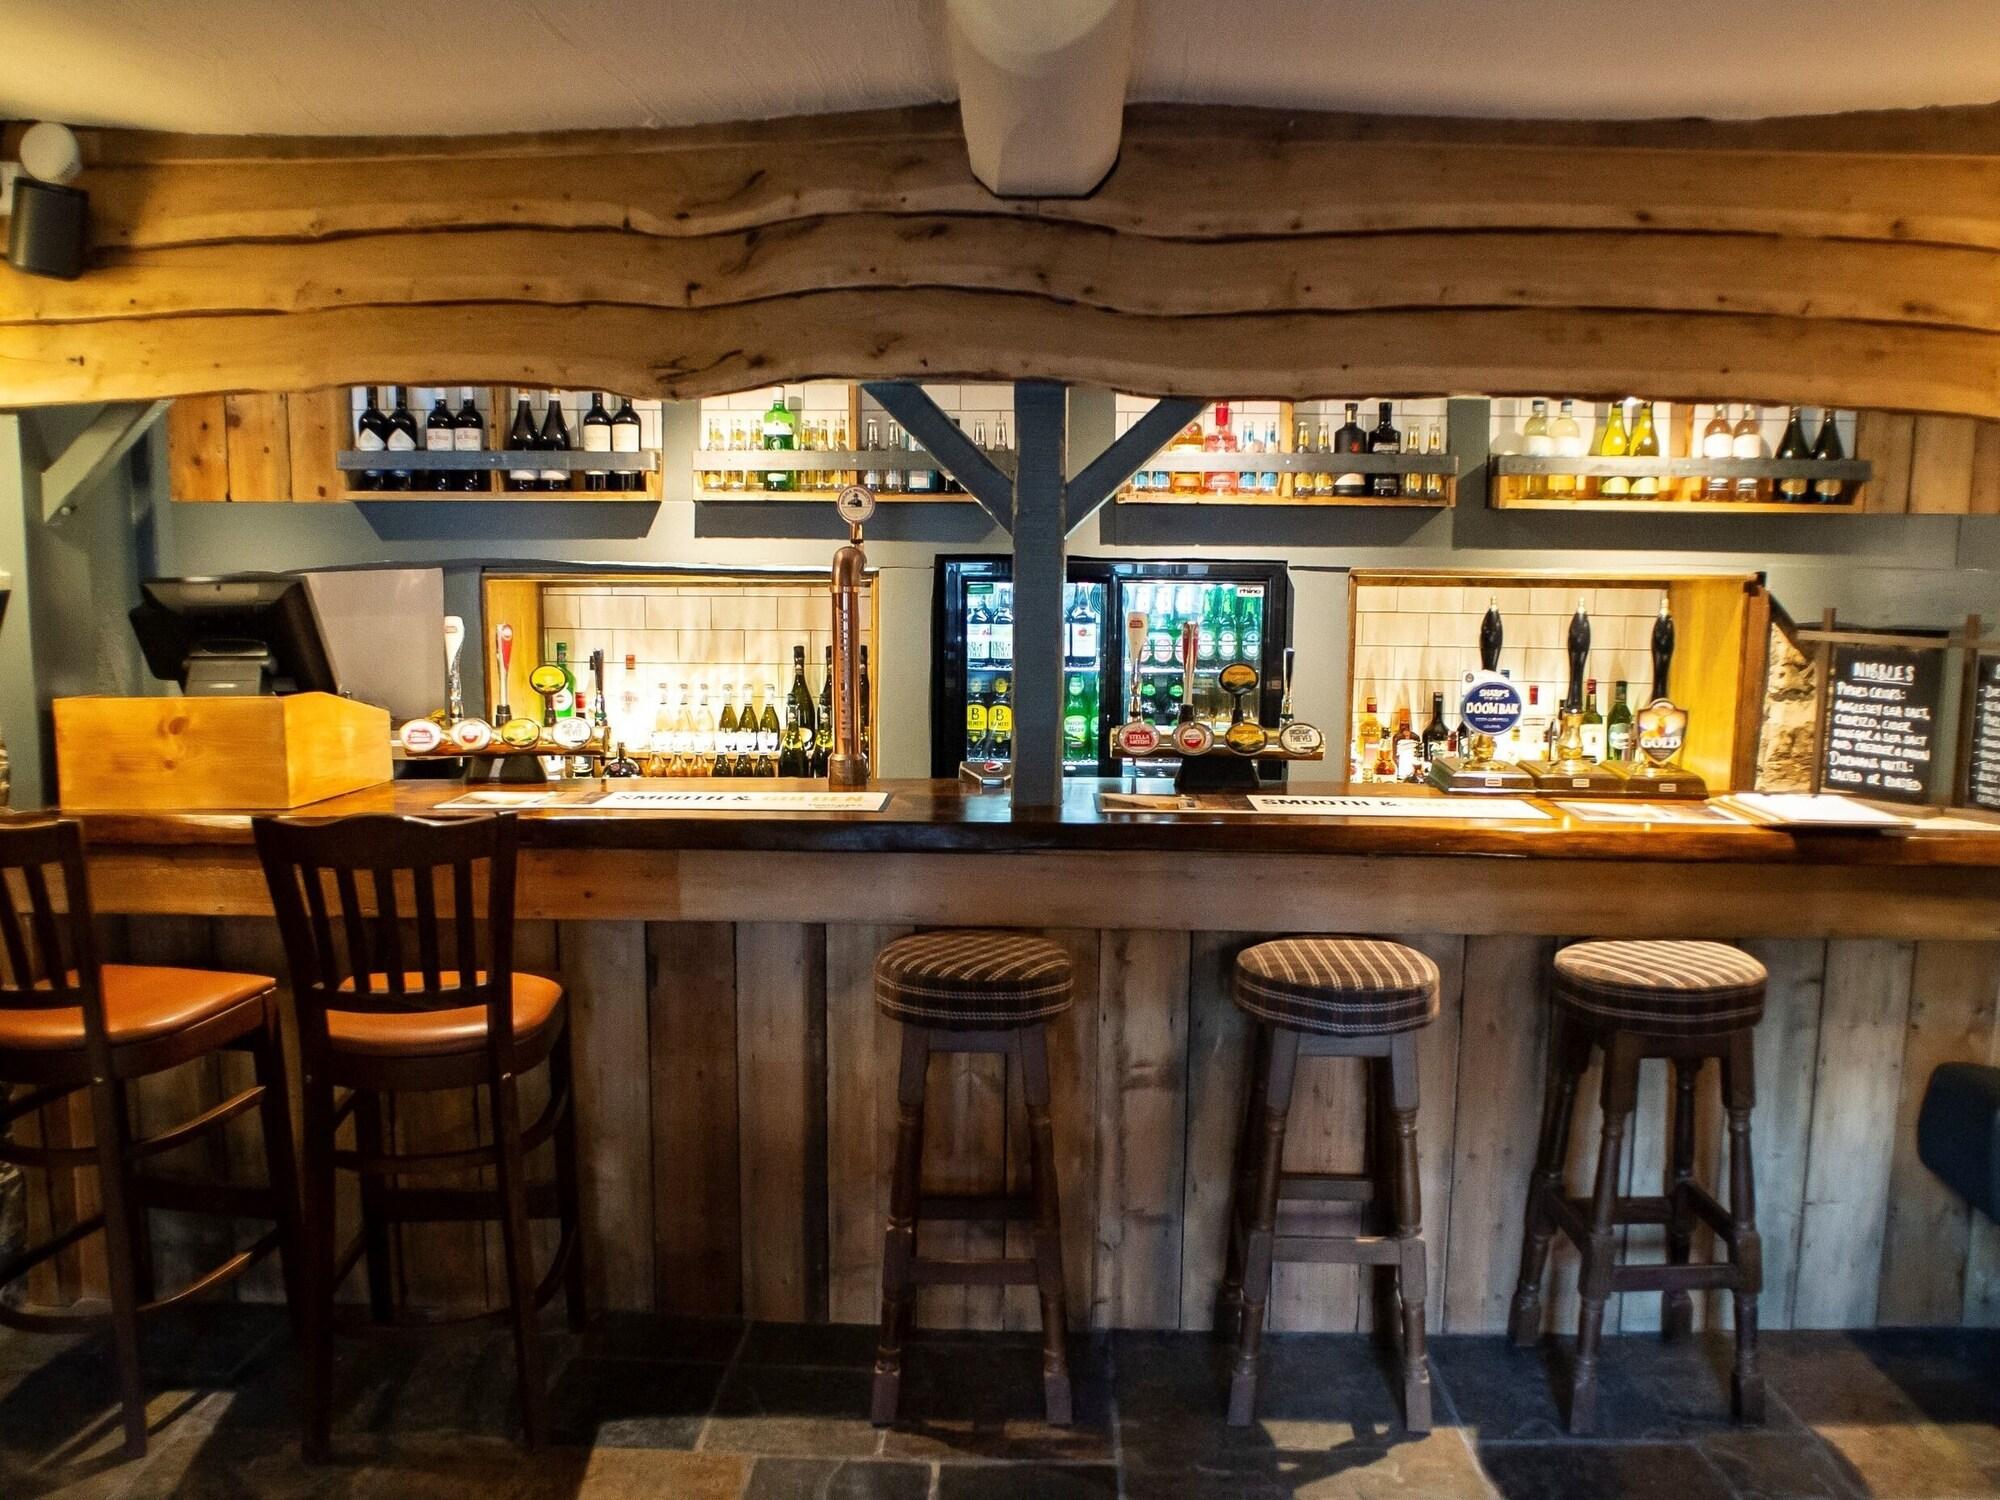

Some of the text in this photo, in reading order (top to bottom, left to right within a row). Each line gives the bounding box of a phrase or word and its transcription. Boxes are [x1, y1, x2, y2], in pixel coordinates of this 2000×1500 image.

[1239, 587, 1262, 595] rhino
[1852, 662, 1915, 682] NIBBLES
[1466, 702, 1499, 714] DOOM
[1882, 705, 1903, 718] SEA
[1289, 734, 1312, 742] THIEVES
[616, 794, 723, 802] SMOOTH
[1261, 798, 1369, 807] SMOOTH
[1380, 800, 1401, 808] &
